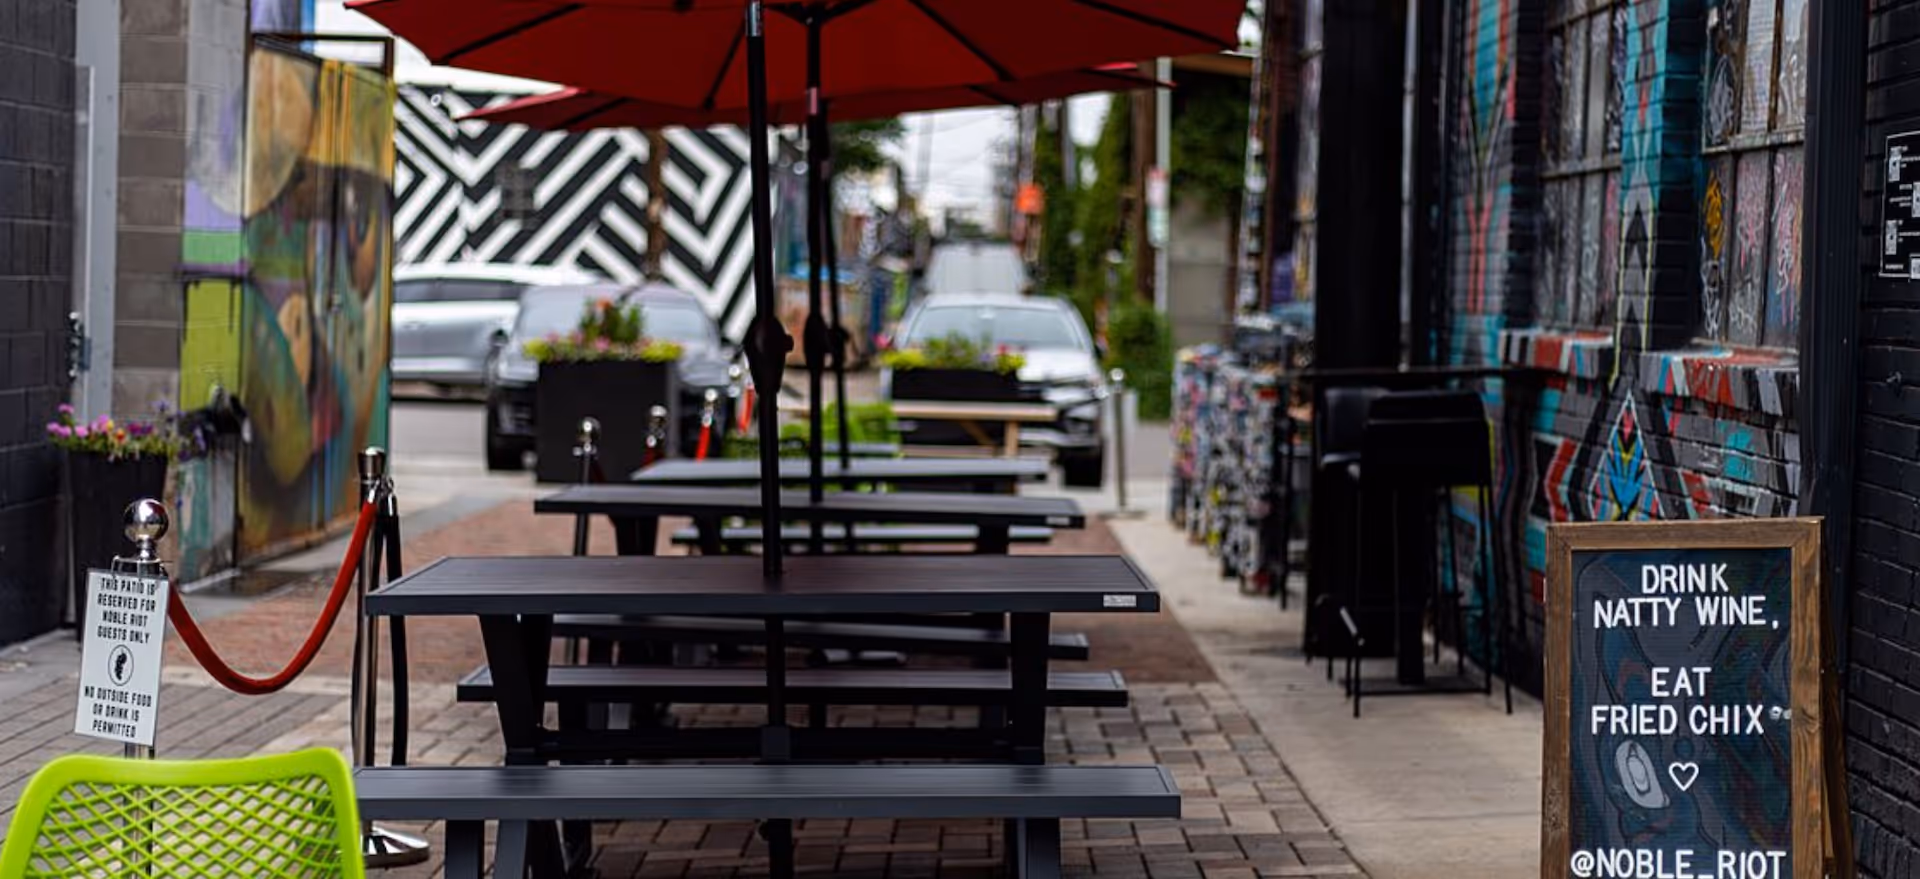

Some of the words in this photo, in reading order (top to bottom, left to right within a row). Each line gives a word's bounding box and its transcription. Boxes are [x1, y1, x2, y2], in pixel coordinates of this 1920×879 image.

[101, 577, 118, 590] THIS
[121, 580, 145, 594] PATIO
[147, 584, 155, 596] IS
[1641, 563, 1729, 594] DRINK
[97, 593, 138, 610] RESERVED
[140, 598, 156, 612] FOR
[1593, 597, 1682, 628] NATTY
[1695, 595, 1779, 630] WINE,
[102, 612, 128, 625] NOBLE
[130, 614, 148, 627] RIOT
[97, 626, 126, 641] GUESTS
[129, 630, 151, 644] ONLY
[1651, 667, 1712, 697] EAT
[84, 686, 95, 699] NO
[97, 688, 129, 704] OUTSIDE
[131, 692, 152, 707] FOOD
[93, 703, 103, 716] OR
[106, 705, 128, 719] DRINK
[131, 709, 140, 722] IS
[1591, 705, 1678, 735] FRIED
[1689, 704, 1765, 735] CHIX
[92, 720, 136, 738] PERMITTED
[1571, 848, 1787, 879] @NOBLE_RIOT
